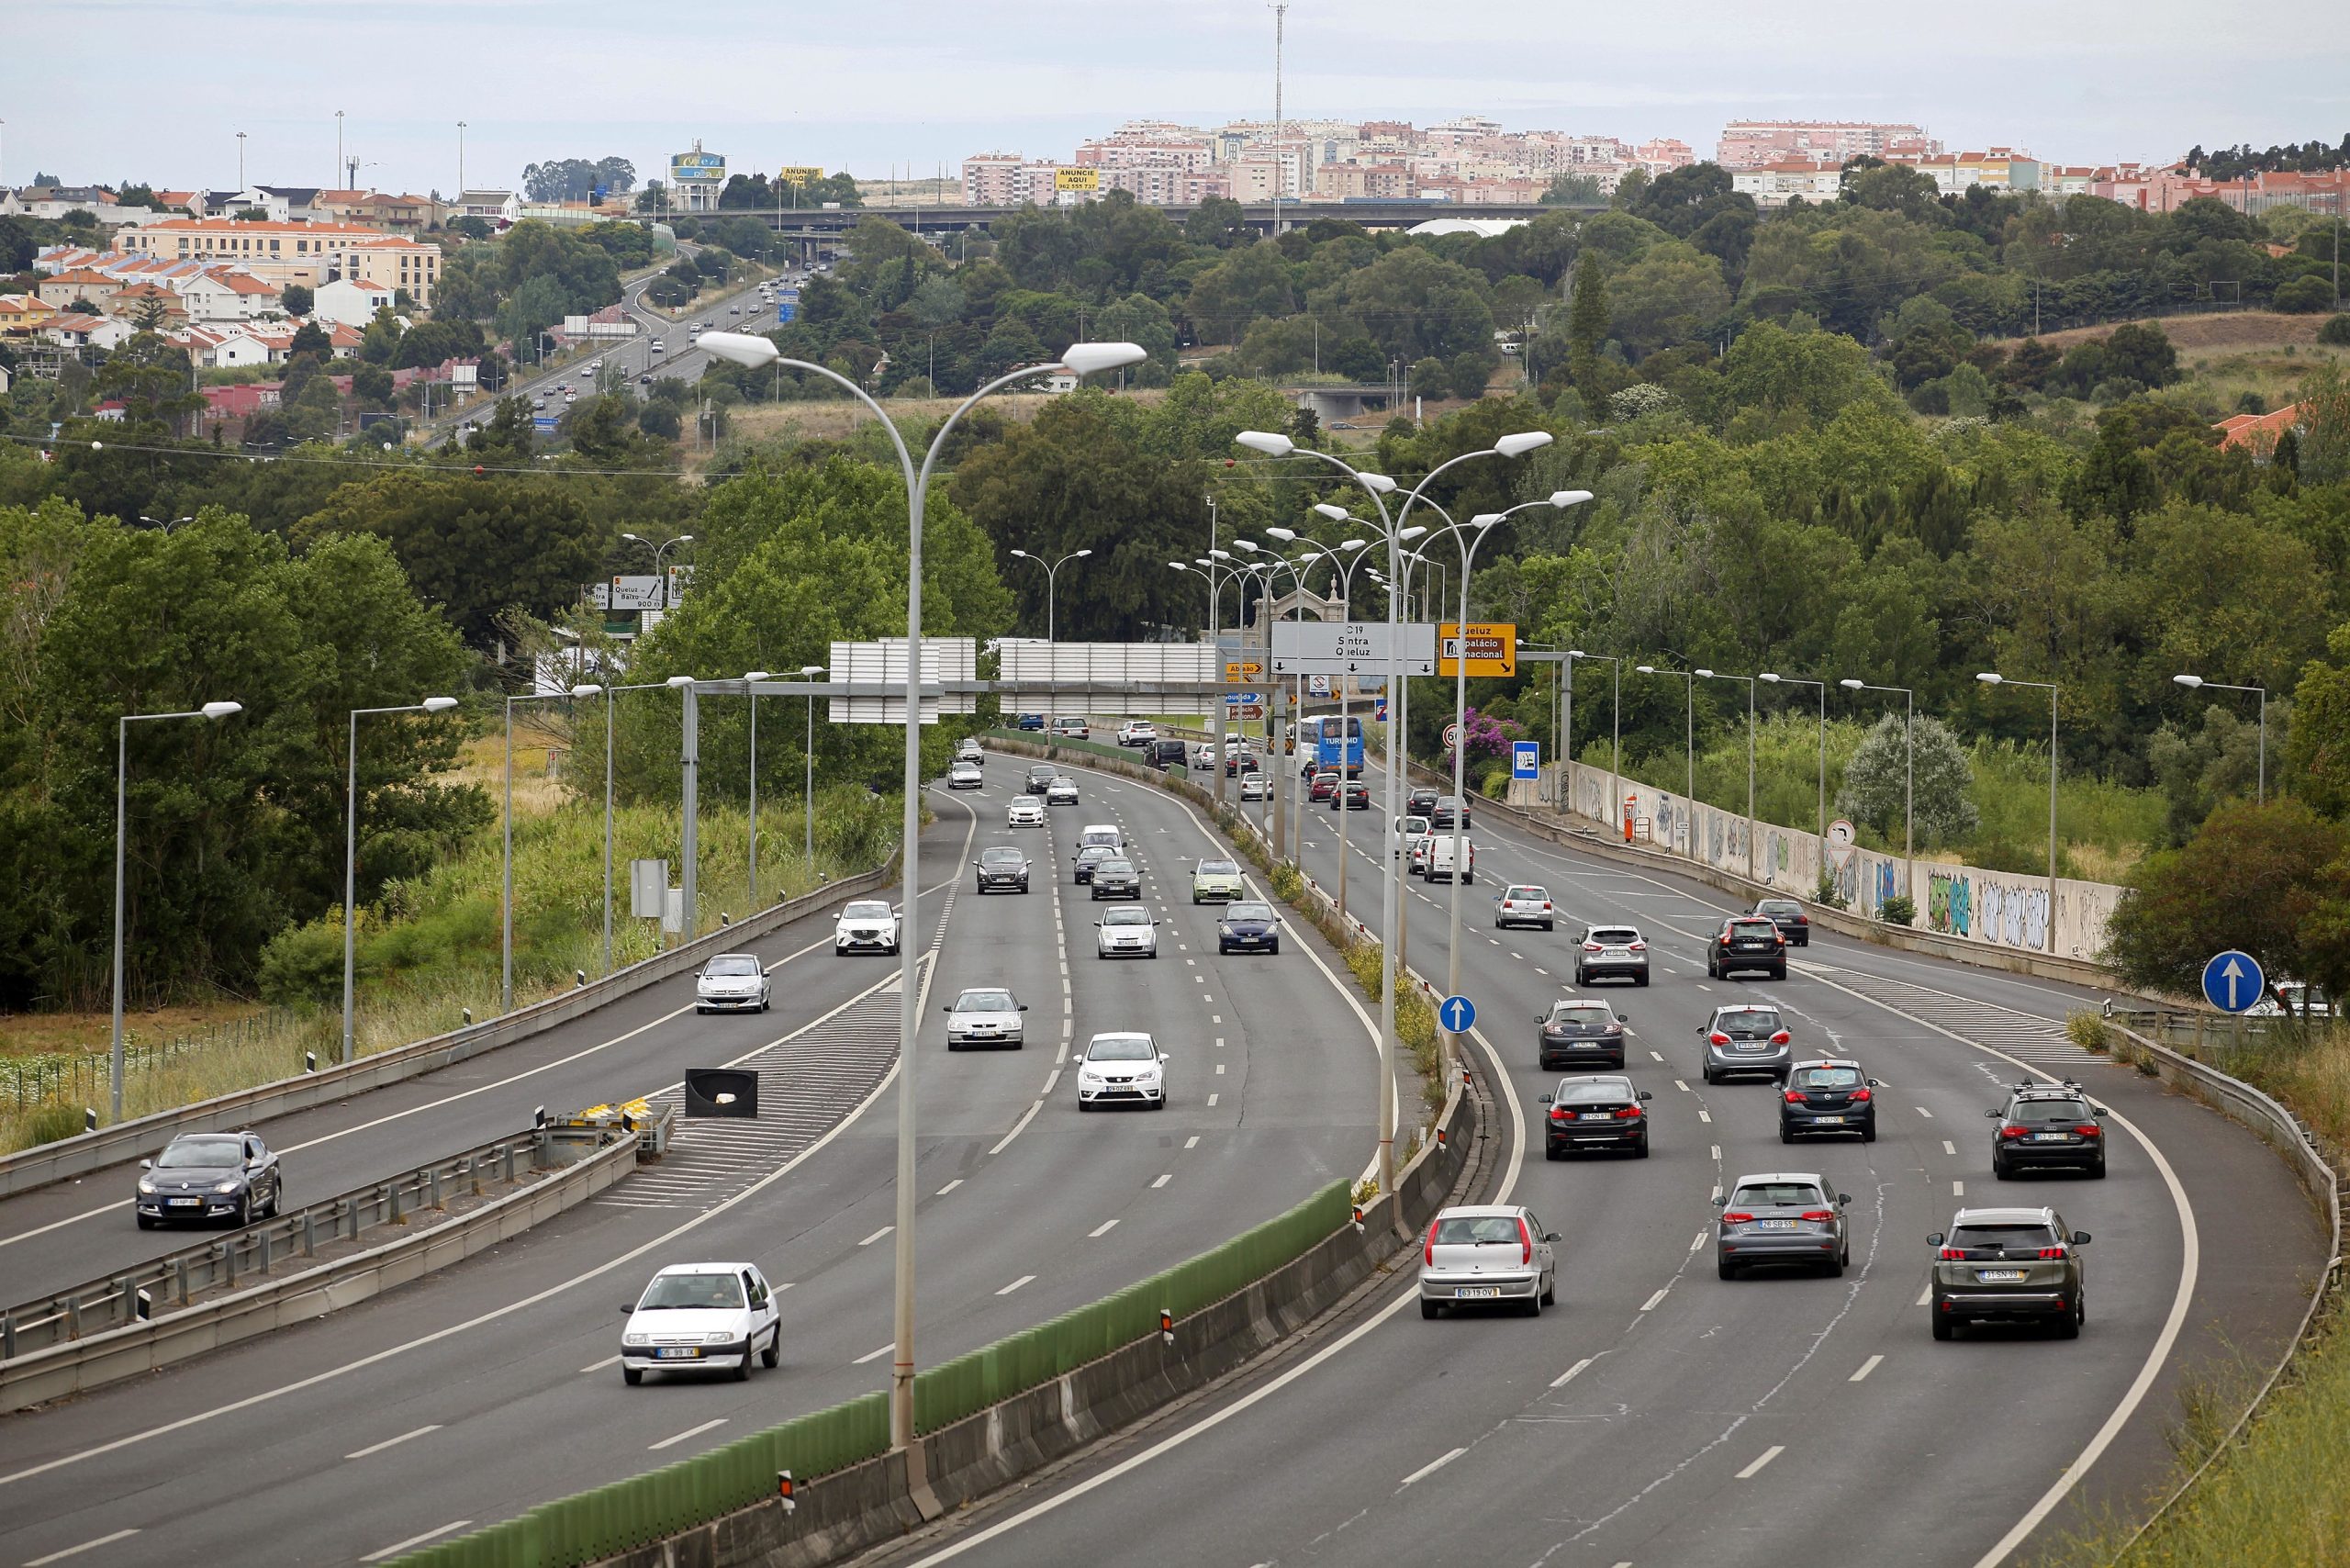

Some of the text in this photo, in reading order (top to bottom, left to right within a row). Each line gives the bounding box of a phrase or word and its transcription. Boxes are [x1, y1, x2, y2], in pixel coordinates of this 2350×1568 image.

[1337, 636, 1369, 645] Sntra
[1336, 647, 1371, 656] Qeluz
[1464, 649, 1504, 658] nacional
